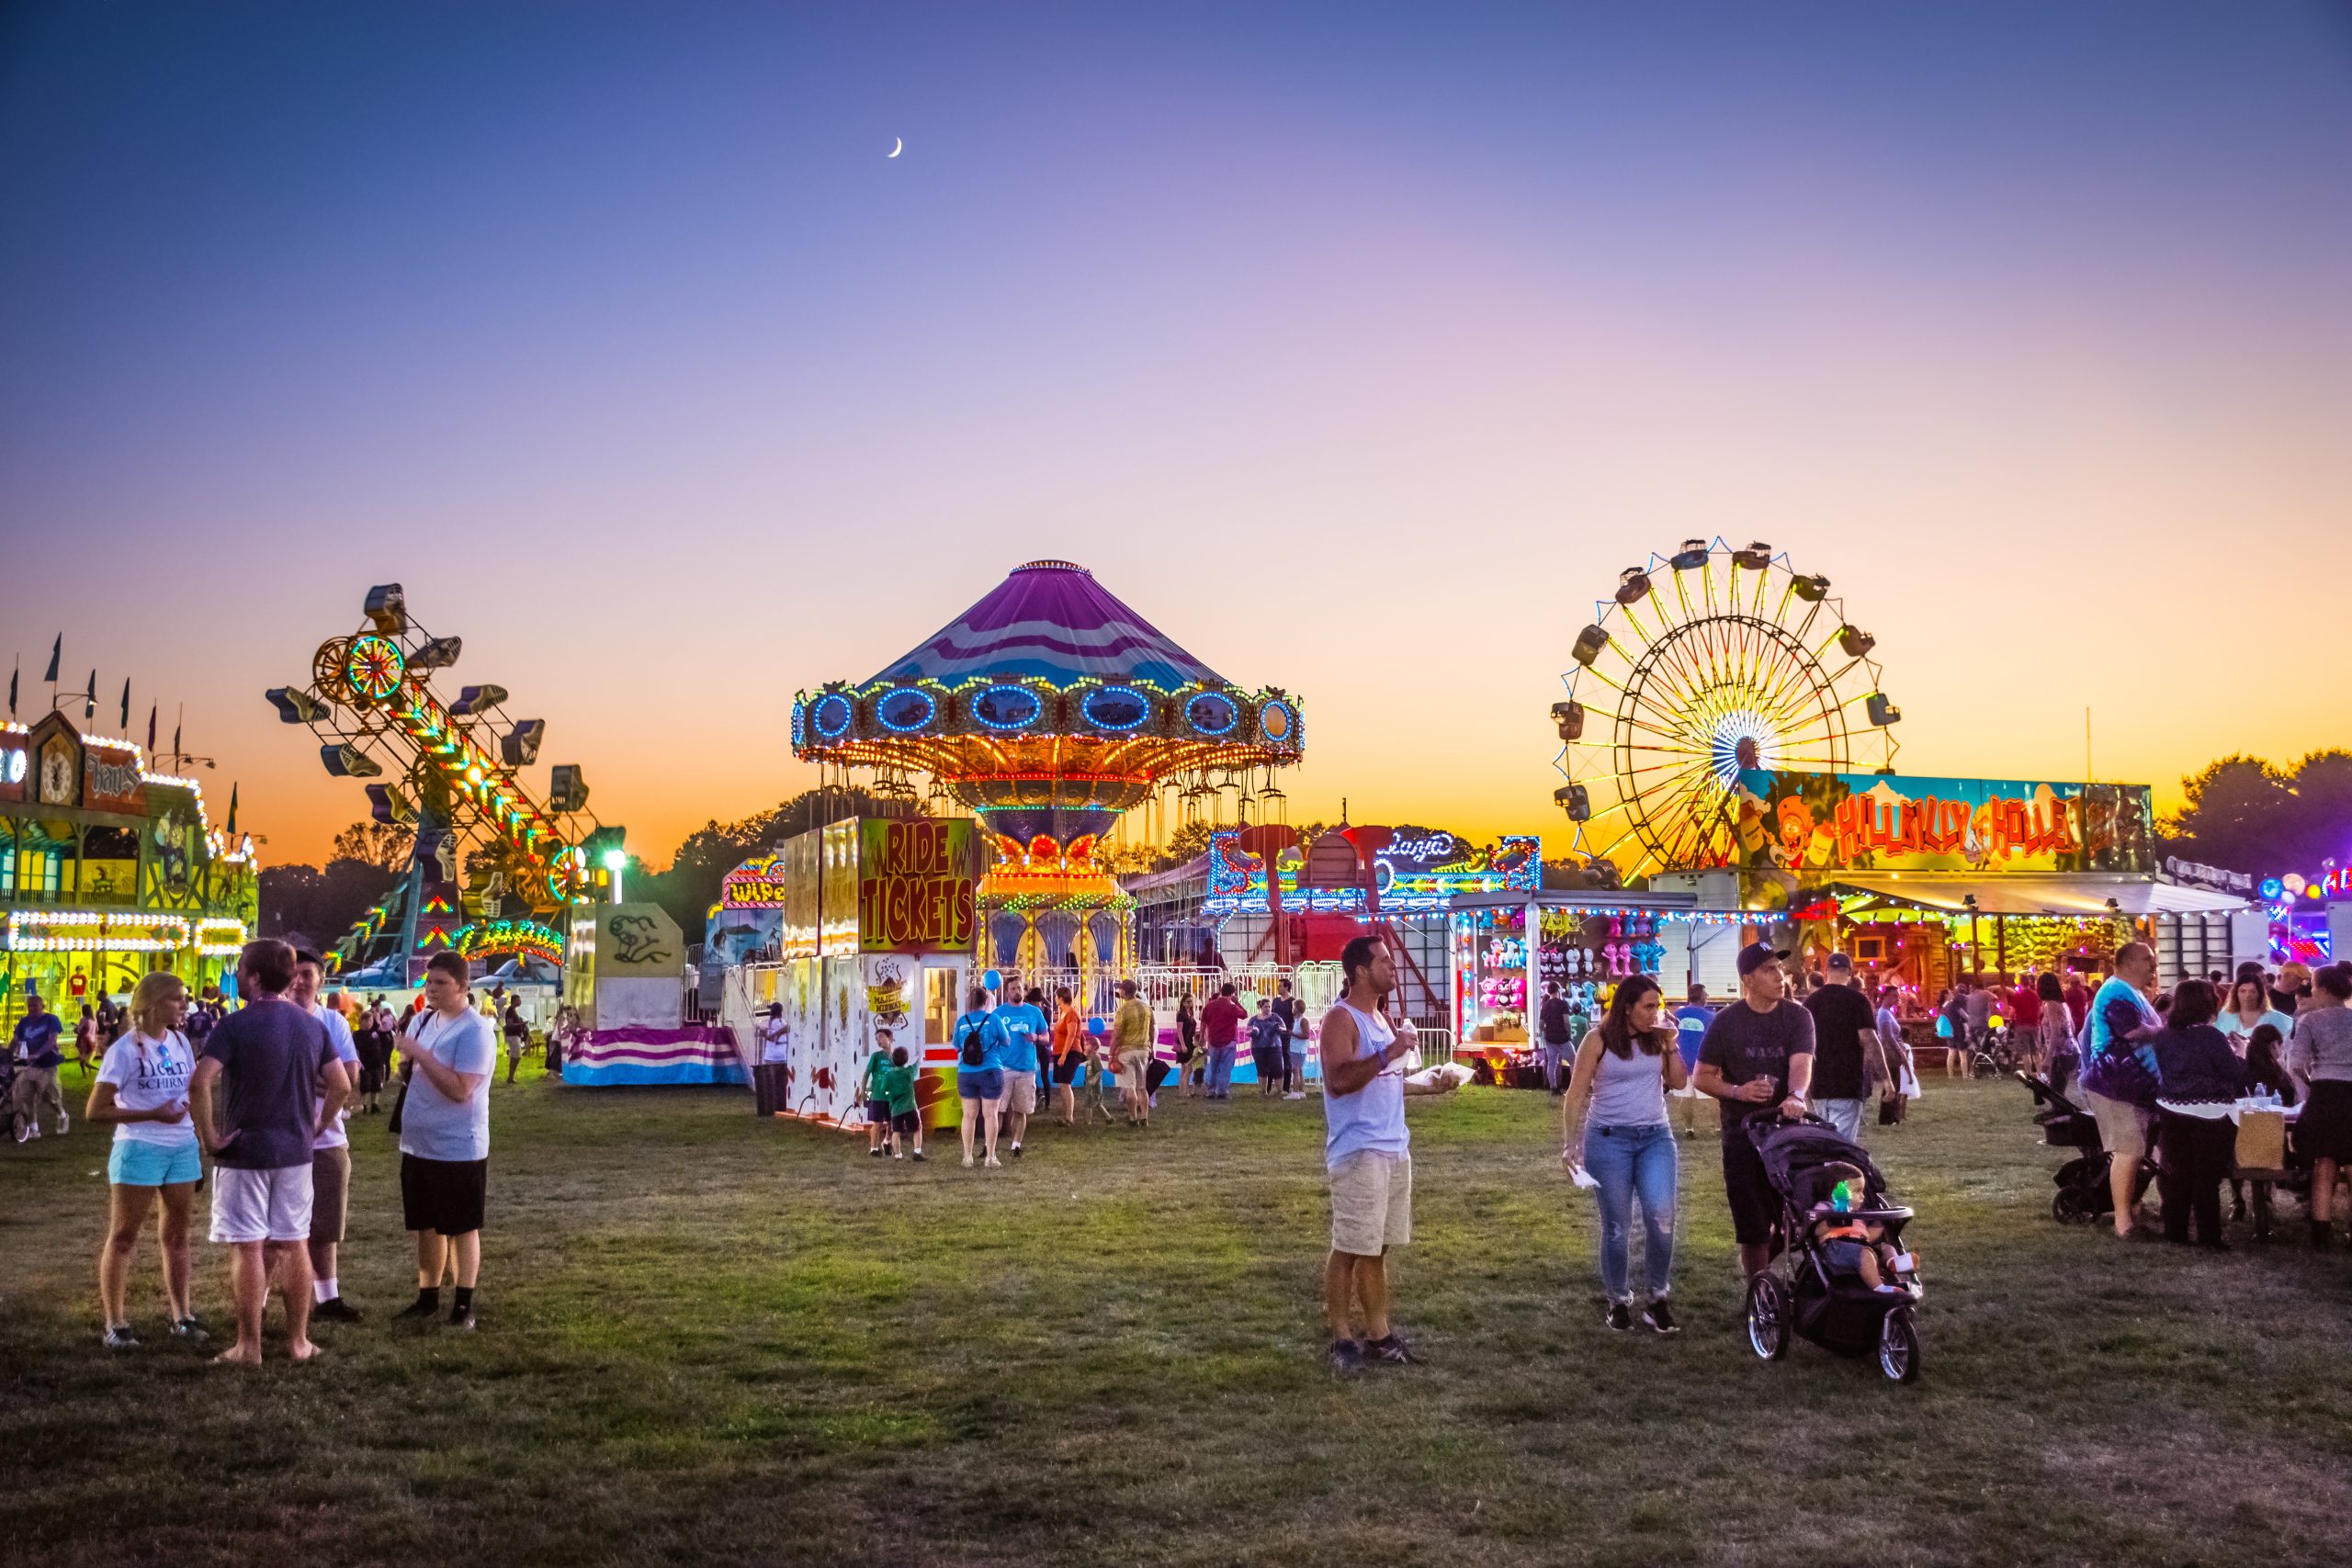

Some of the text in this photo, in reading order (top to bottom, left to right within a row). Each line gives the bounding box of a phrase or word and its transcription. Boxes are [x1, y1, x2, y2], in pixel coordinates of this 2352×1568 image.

[886, 821, 949, 875] RIDE
[1835, 793, 1972, 865] HILLBILLY
[861, 875, 974, 945] TICKETS
